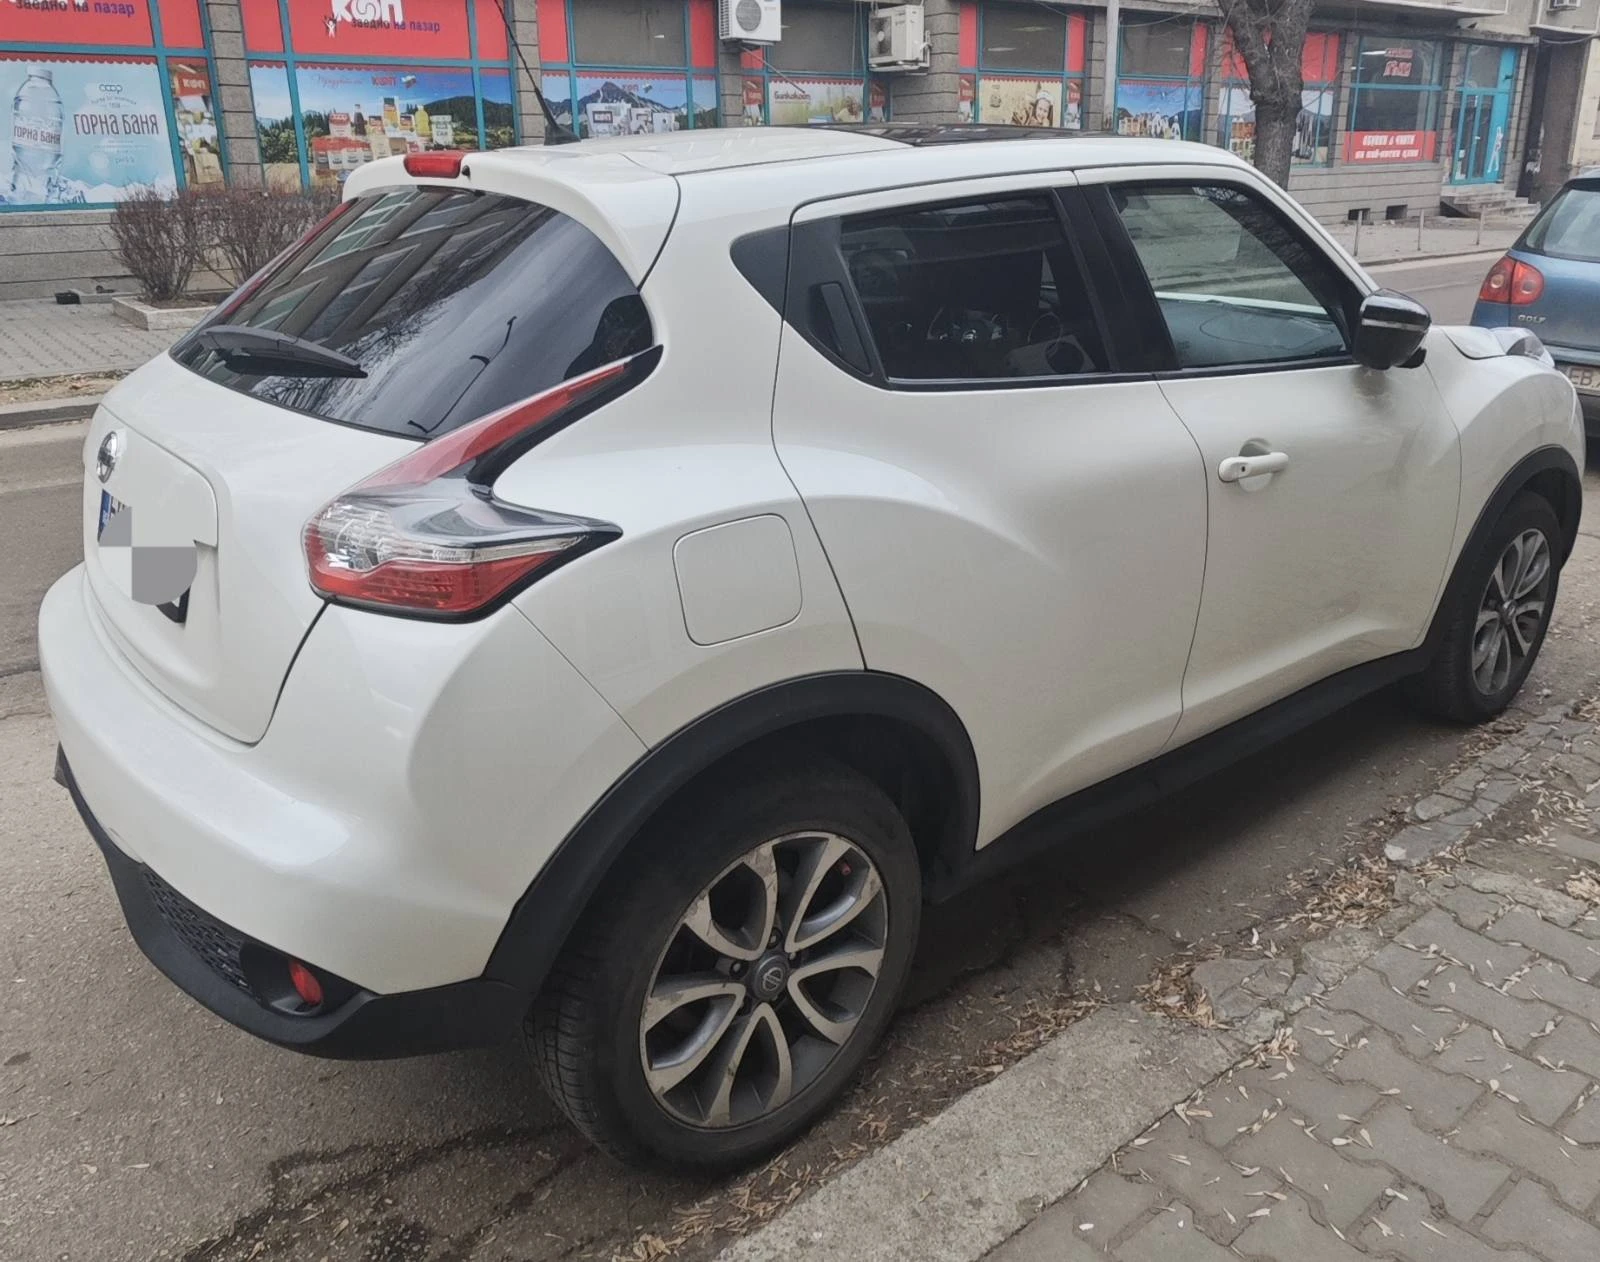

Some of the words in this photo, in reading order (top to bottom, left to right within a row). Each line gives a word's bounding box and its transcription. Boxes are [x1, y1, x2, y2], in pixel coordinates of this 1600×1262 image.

[73, 1, 89, 12] на
[94, 2, 135, 18] пазар
[409, 21, 441, 34] пазар
[1518, 314, 1546, 323] GOLF
